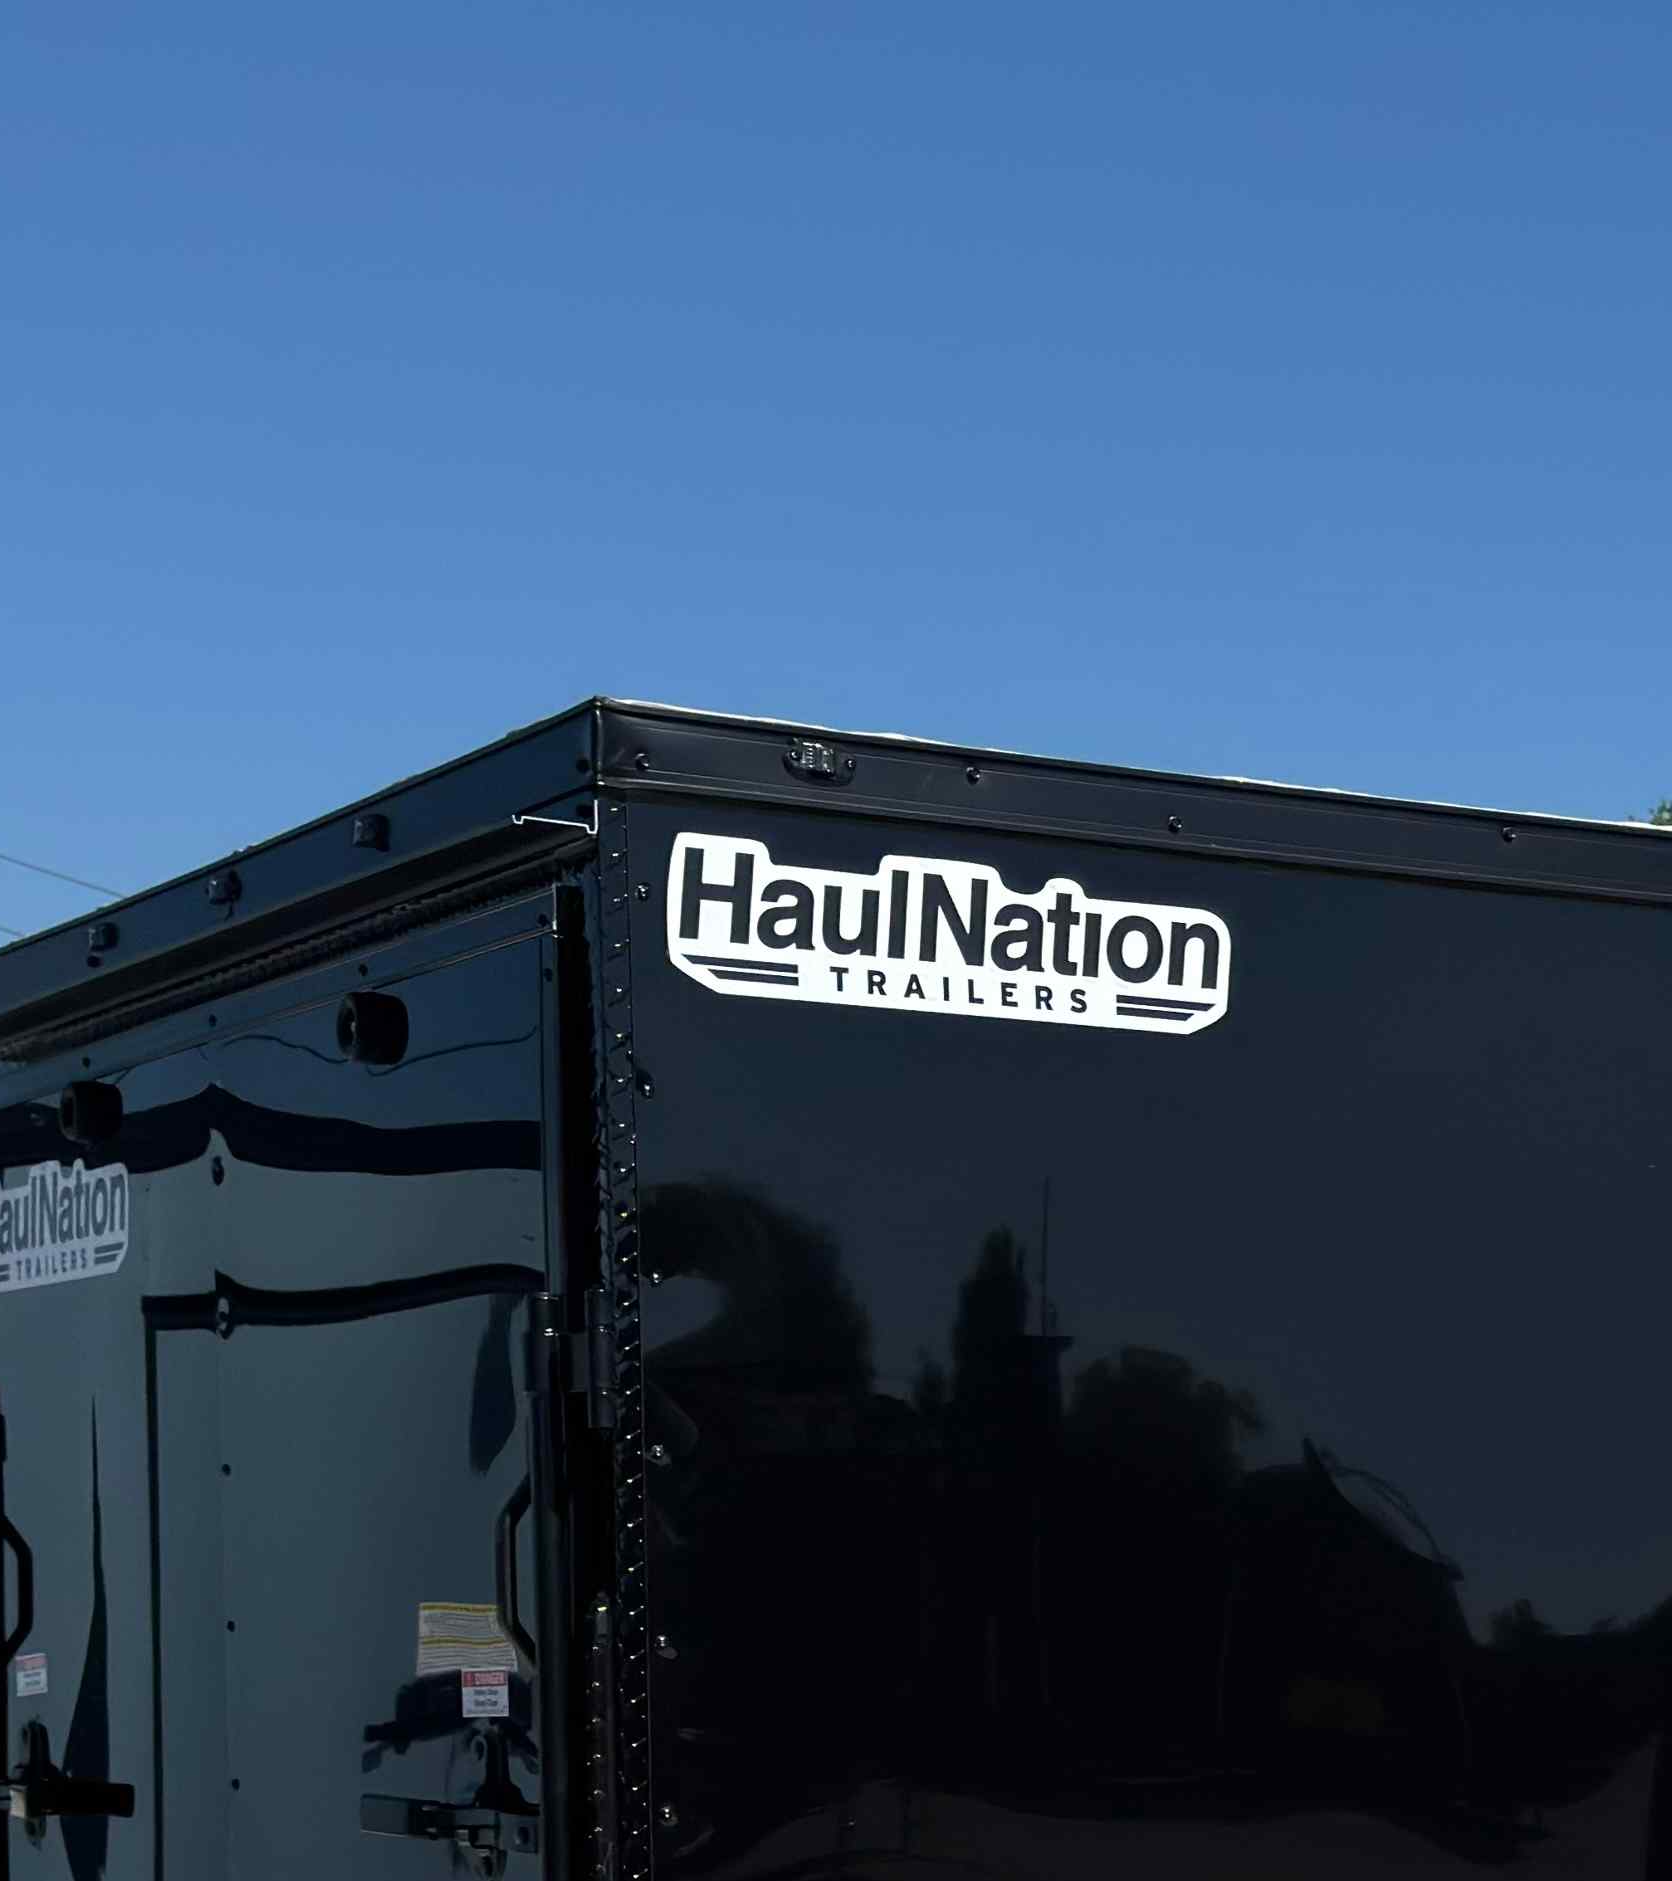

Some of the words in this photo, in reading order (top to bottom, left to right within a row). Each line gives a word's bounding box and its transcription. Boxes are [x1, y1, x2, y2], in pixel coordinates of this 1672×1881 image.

[678, 847, 1219, 990] HaulNation
[829, 966, 1088, 1014] TRAILERS
[15, 1248, 89, 1282] TRAILERS
